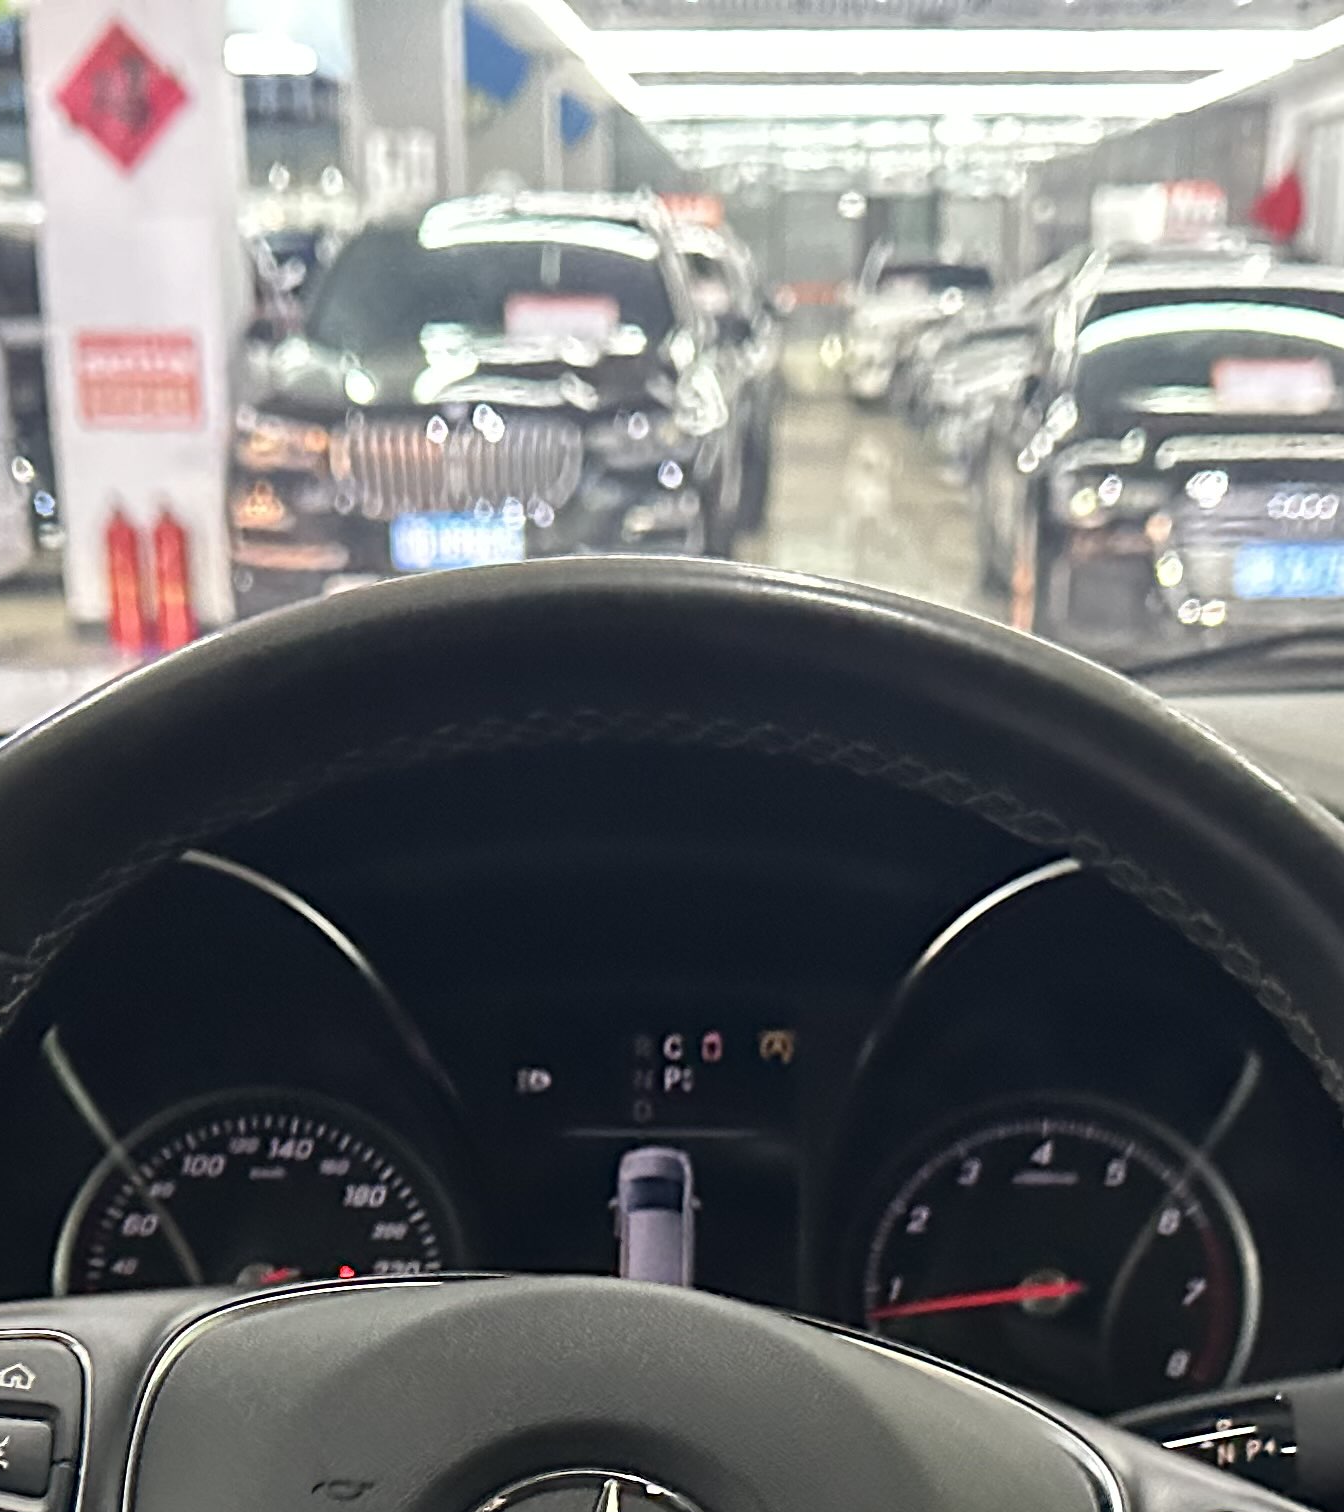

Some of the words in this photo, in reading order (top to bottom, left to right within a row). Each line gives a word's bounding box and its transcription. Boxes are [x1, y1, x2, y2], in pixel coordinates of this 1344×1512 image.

[268, 1138, 315, 1161] 140
[1030, 1139, 1054, 1166] 4
[182, 1153, 226, 1178] 100
[958, 1157, 982, 1186] 3
[343, 1183, 387, 1208] 180
[121, 1213, 159, 1238] 60
[906, 1205, 930, 1234] 2
[889, 1275, 903, 1302] 1
[1182, 1277, 1208, 1307] 7
